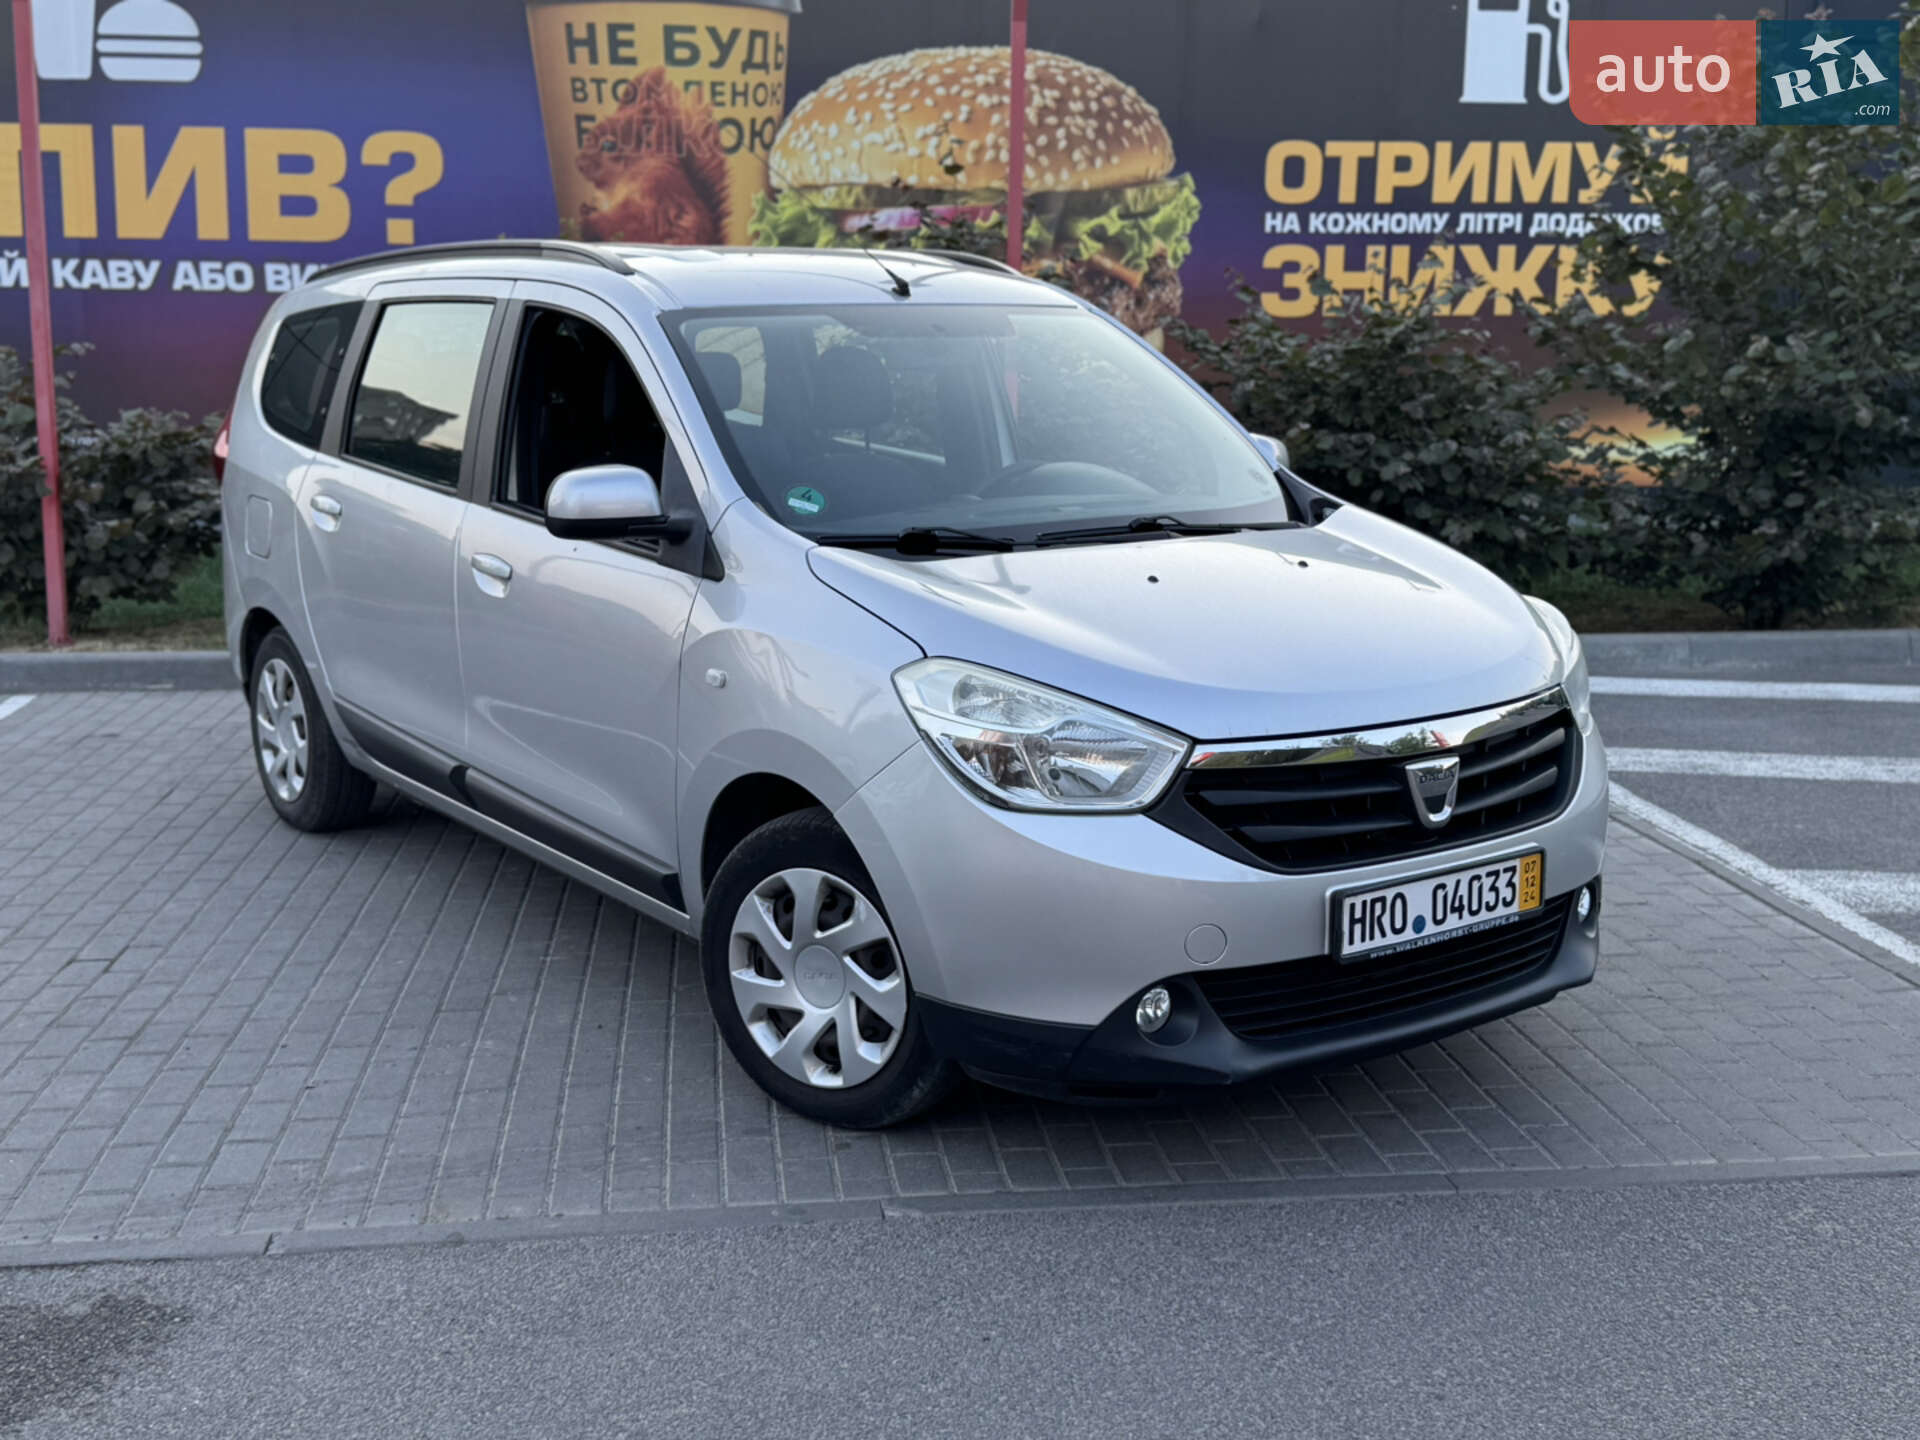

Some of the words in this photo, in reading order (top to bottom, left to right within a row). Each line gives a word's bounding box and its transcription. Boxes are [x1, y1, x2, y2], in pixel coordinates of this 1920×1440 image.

[565, 23, 638, 66] НЕ
[663, 25, 784, 75] БУДЬ
[1264, 212, 1300, 233] НА
[1309, 212, 1450, 234] КОЖНОМУ
[1456, 213, 1523, 234] ЛІТРІ
[52, 258, 161, 290] КАВУ
[172, 260, 254, 292] АБО
[1348, 892, 1408, 946] HRO
[1432, 865, 1518, 926] 04033
